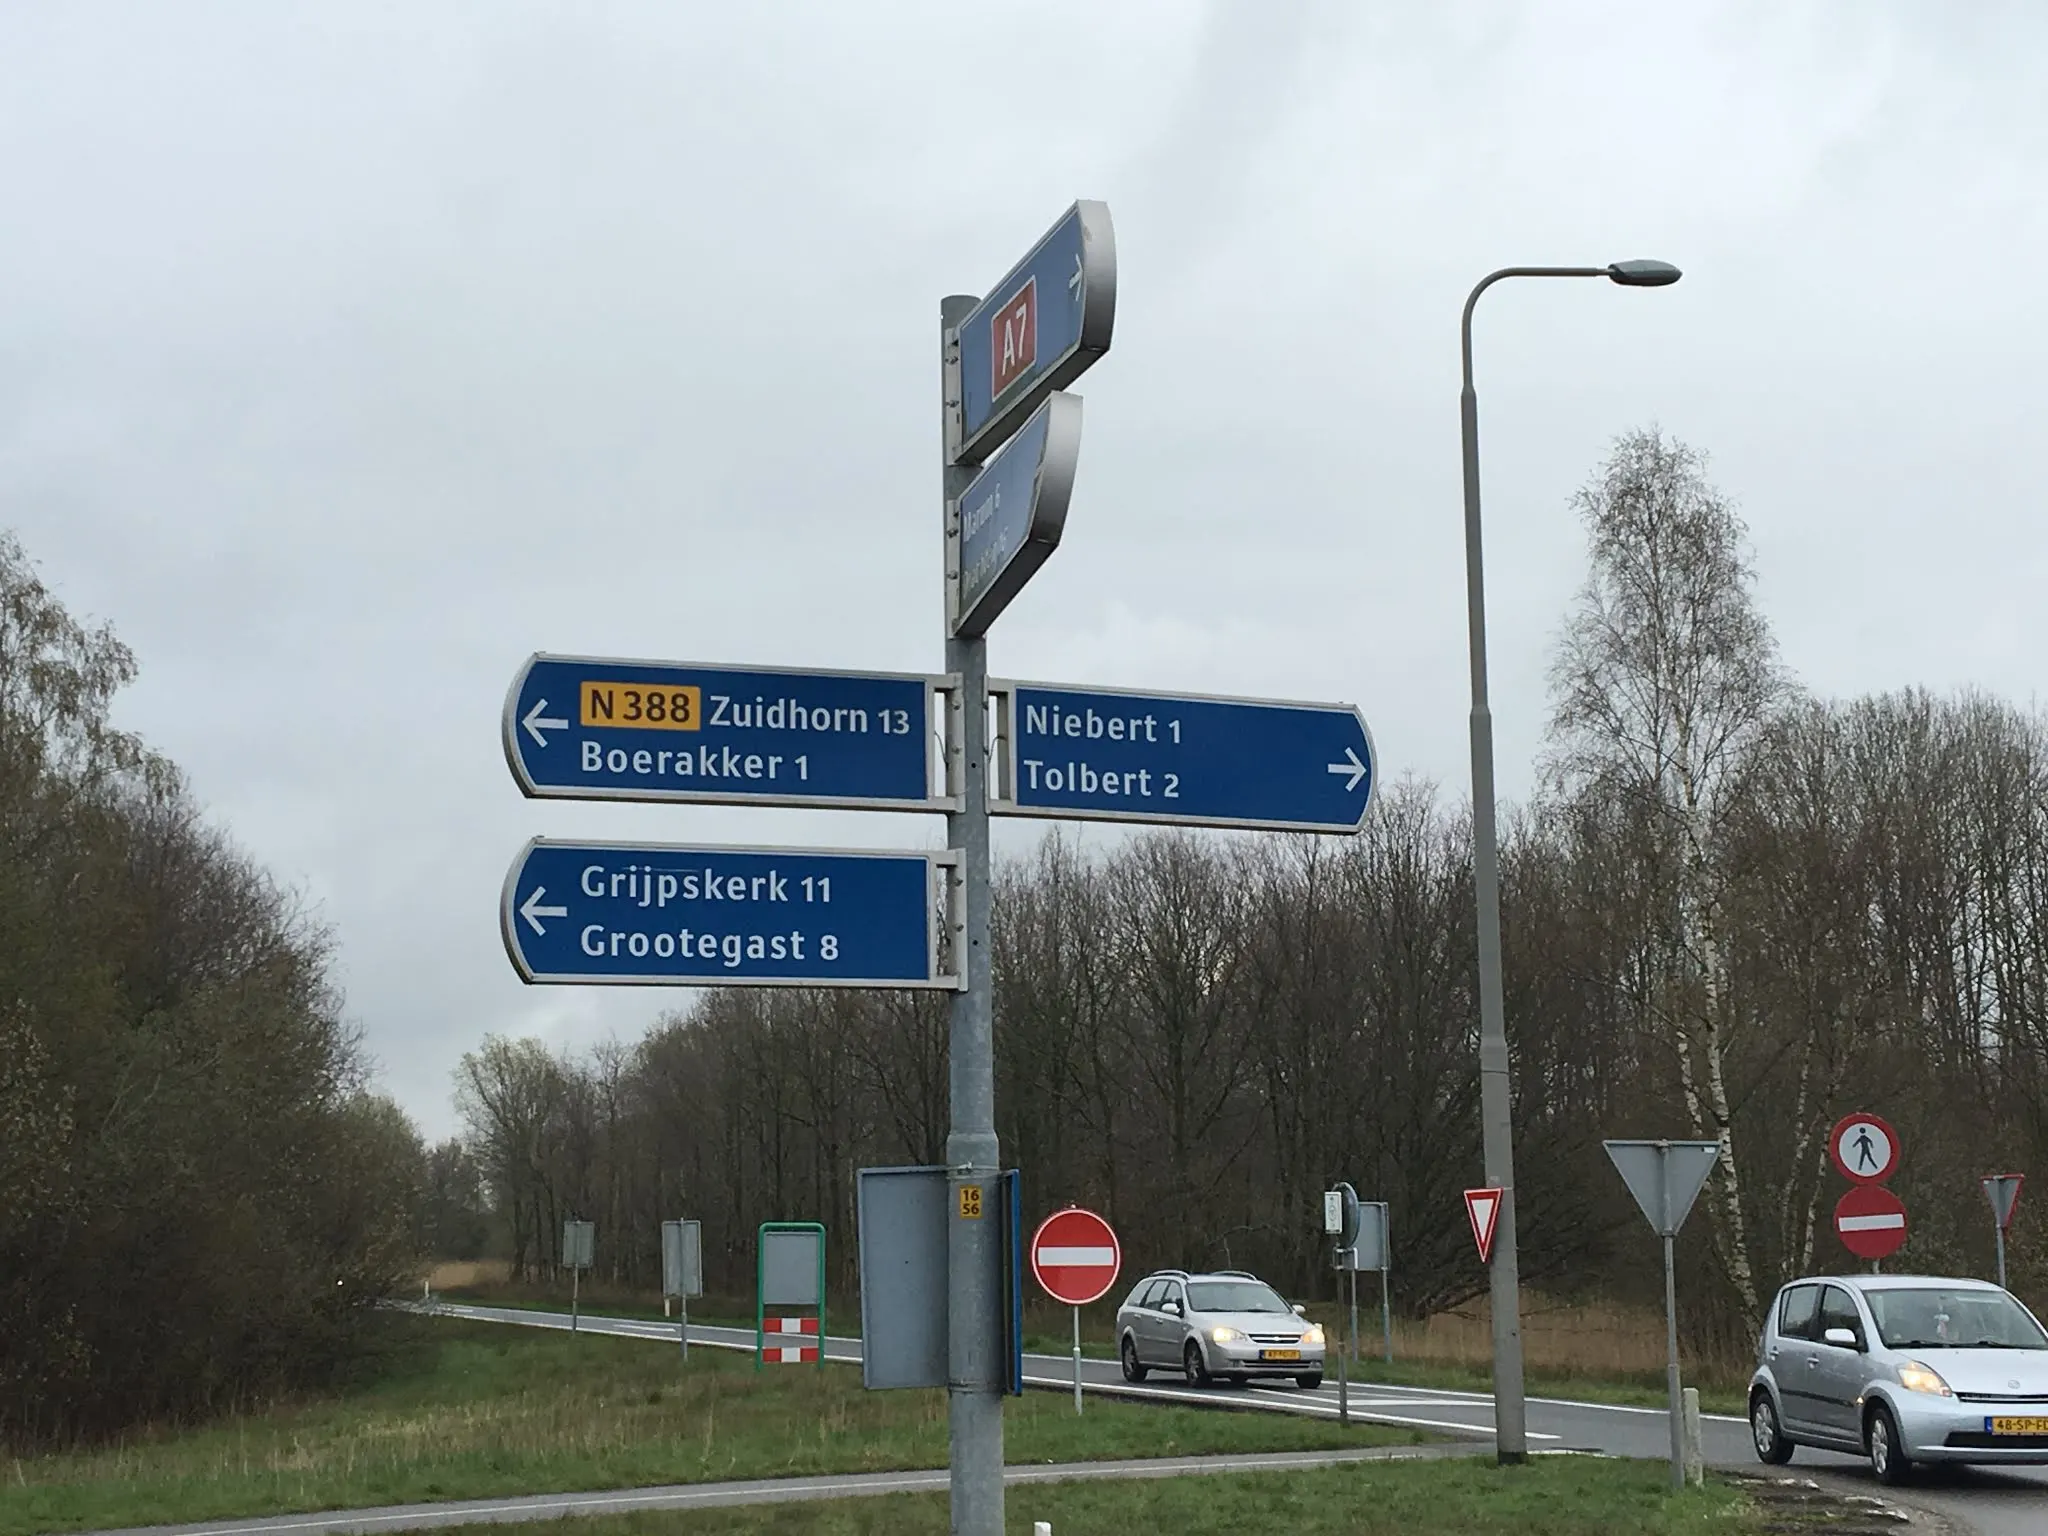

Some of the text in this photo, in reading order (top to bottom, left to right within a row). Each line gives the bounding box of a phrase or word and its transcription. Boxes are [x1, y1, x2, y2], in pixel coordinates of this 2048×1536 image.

[1002, 302, 1027, 377] A7
[622, 691, 691, 723] 388
[709, 695, 868, 733] Zuidhorn
[878, 709, 910, 735] 13
[1026, 704, 1181, 744] Niebert 1
[581, 740, 809, 781] Boerakker 1
[1023, 759, 1180, 798] Tolbert 2
[581, 865, 831, 908] Grijpskerk 11
[581, 924, 839, 968] Grootegast 8
[962, 1203, 980, 1215] 56
[963, 1190, 980, 1201] 16
